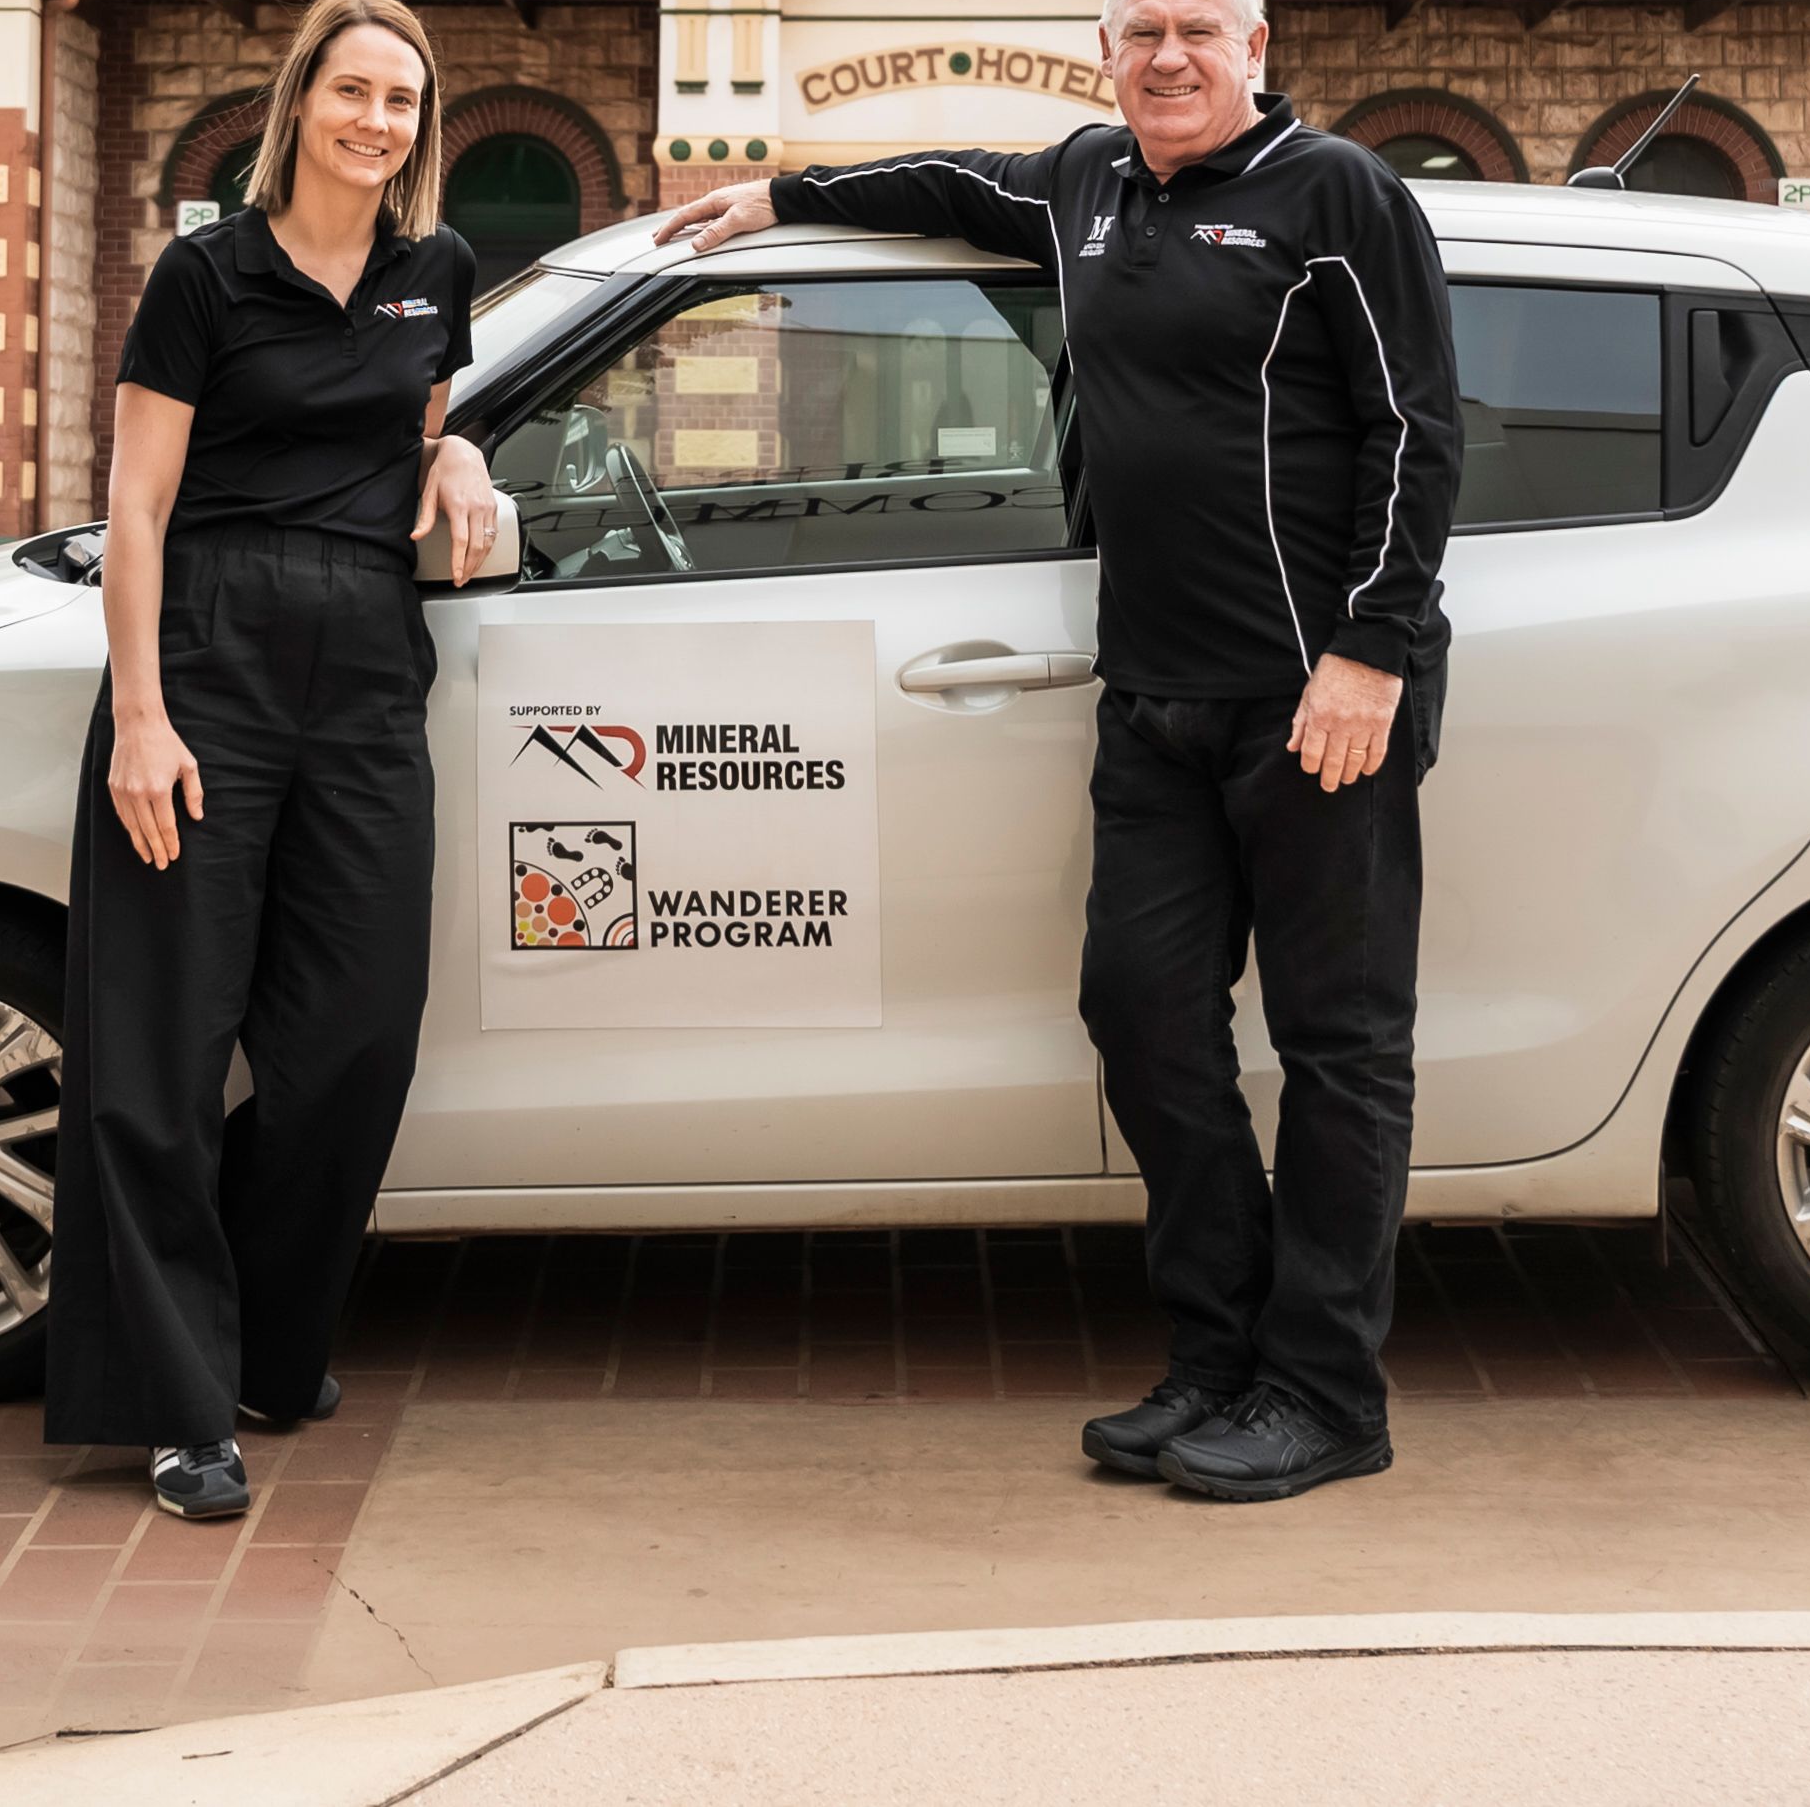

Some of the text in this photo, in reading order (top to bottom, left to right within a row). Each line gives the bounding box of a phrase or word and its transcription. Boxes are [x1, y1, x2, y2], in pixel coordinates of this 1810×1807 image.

[801, 47, 1116, 109] COURT HOTEL
[184, 207, 214, 225] 2P
[509, 705, 602, 716] SUPPORTED BY
[656, 724, 799, 754] MINERAL
[656, 760, 846, 791] RESOURCES
[648, 890, 848, 917] WANDERER
[650, 921, 833, 948] PROGRAM
